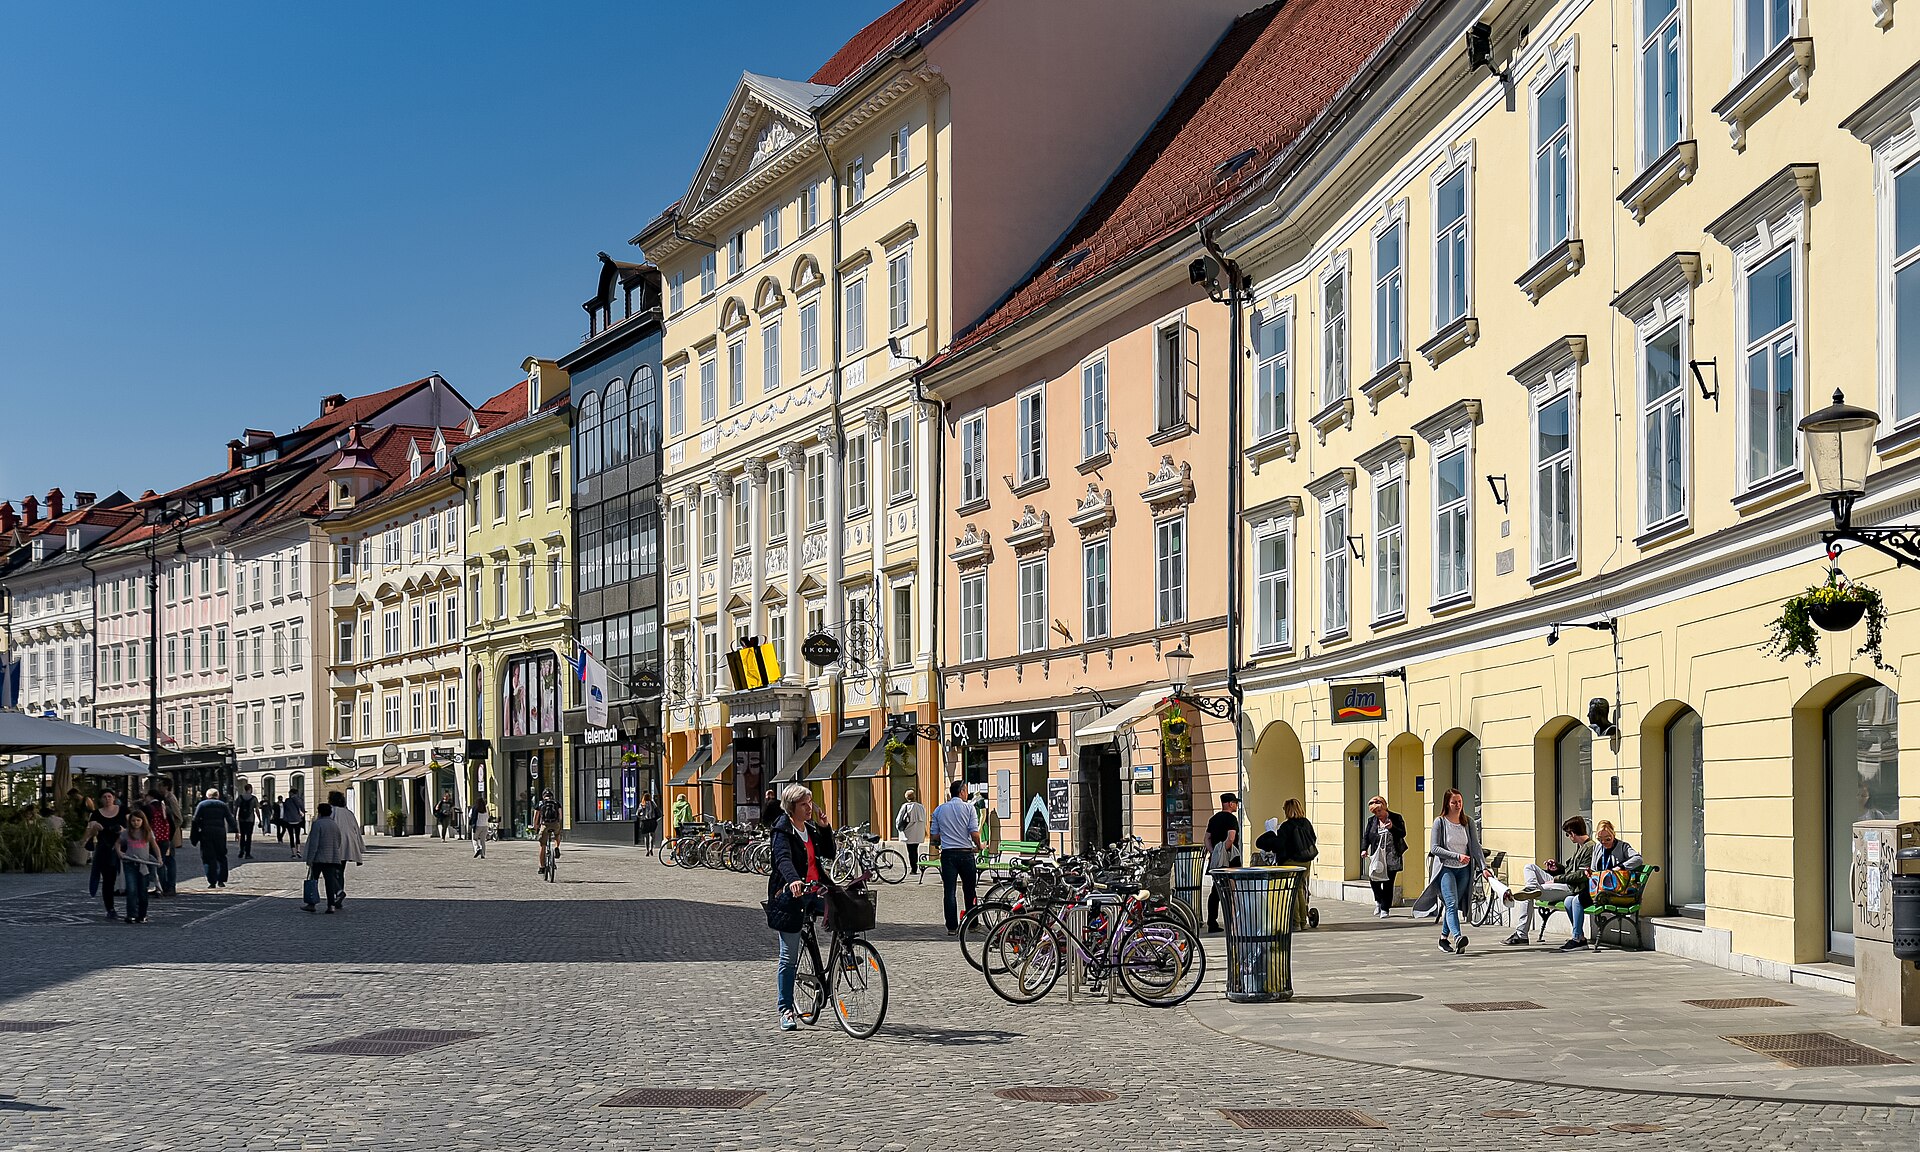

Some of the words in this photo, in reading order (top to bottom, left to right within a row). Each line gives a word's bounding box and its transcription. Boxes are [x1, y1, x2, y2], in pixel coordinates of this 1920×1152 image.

[1344, 687, 1376, 708] dm
[584, 724, 618, 744] telemach
[978, 715, 1021, 740] FOOTBALL
